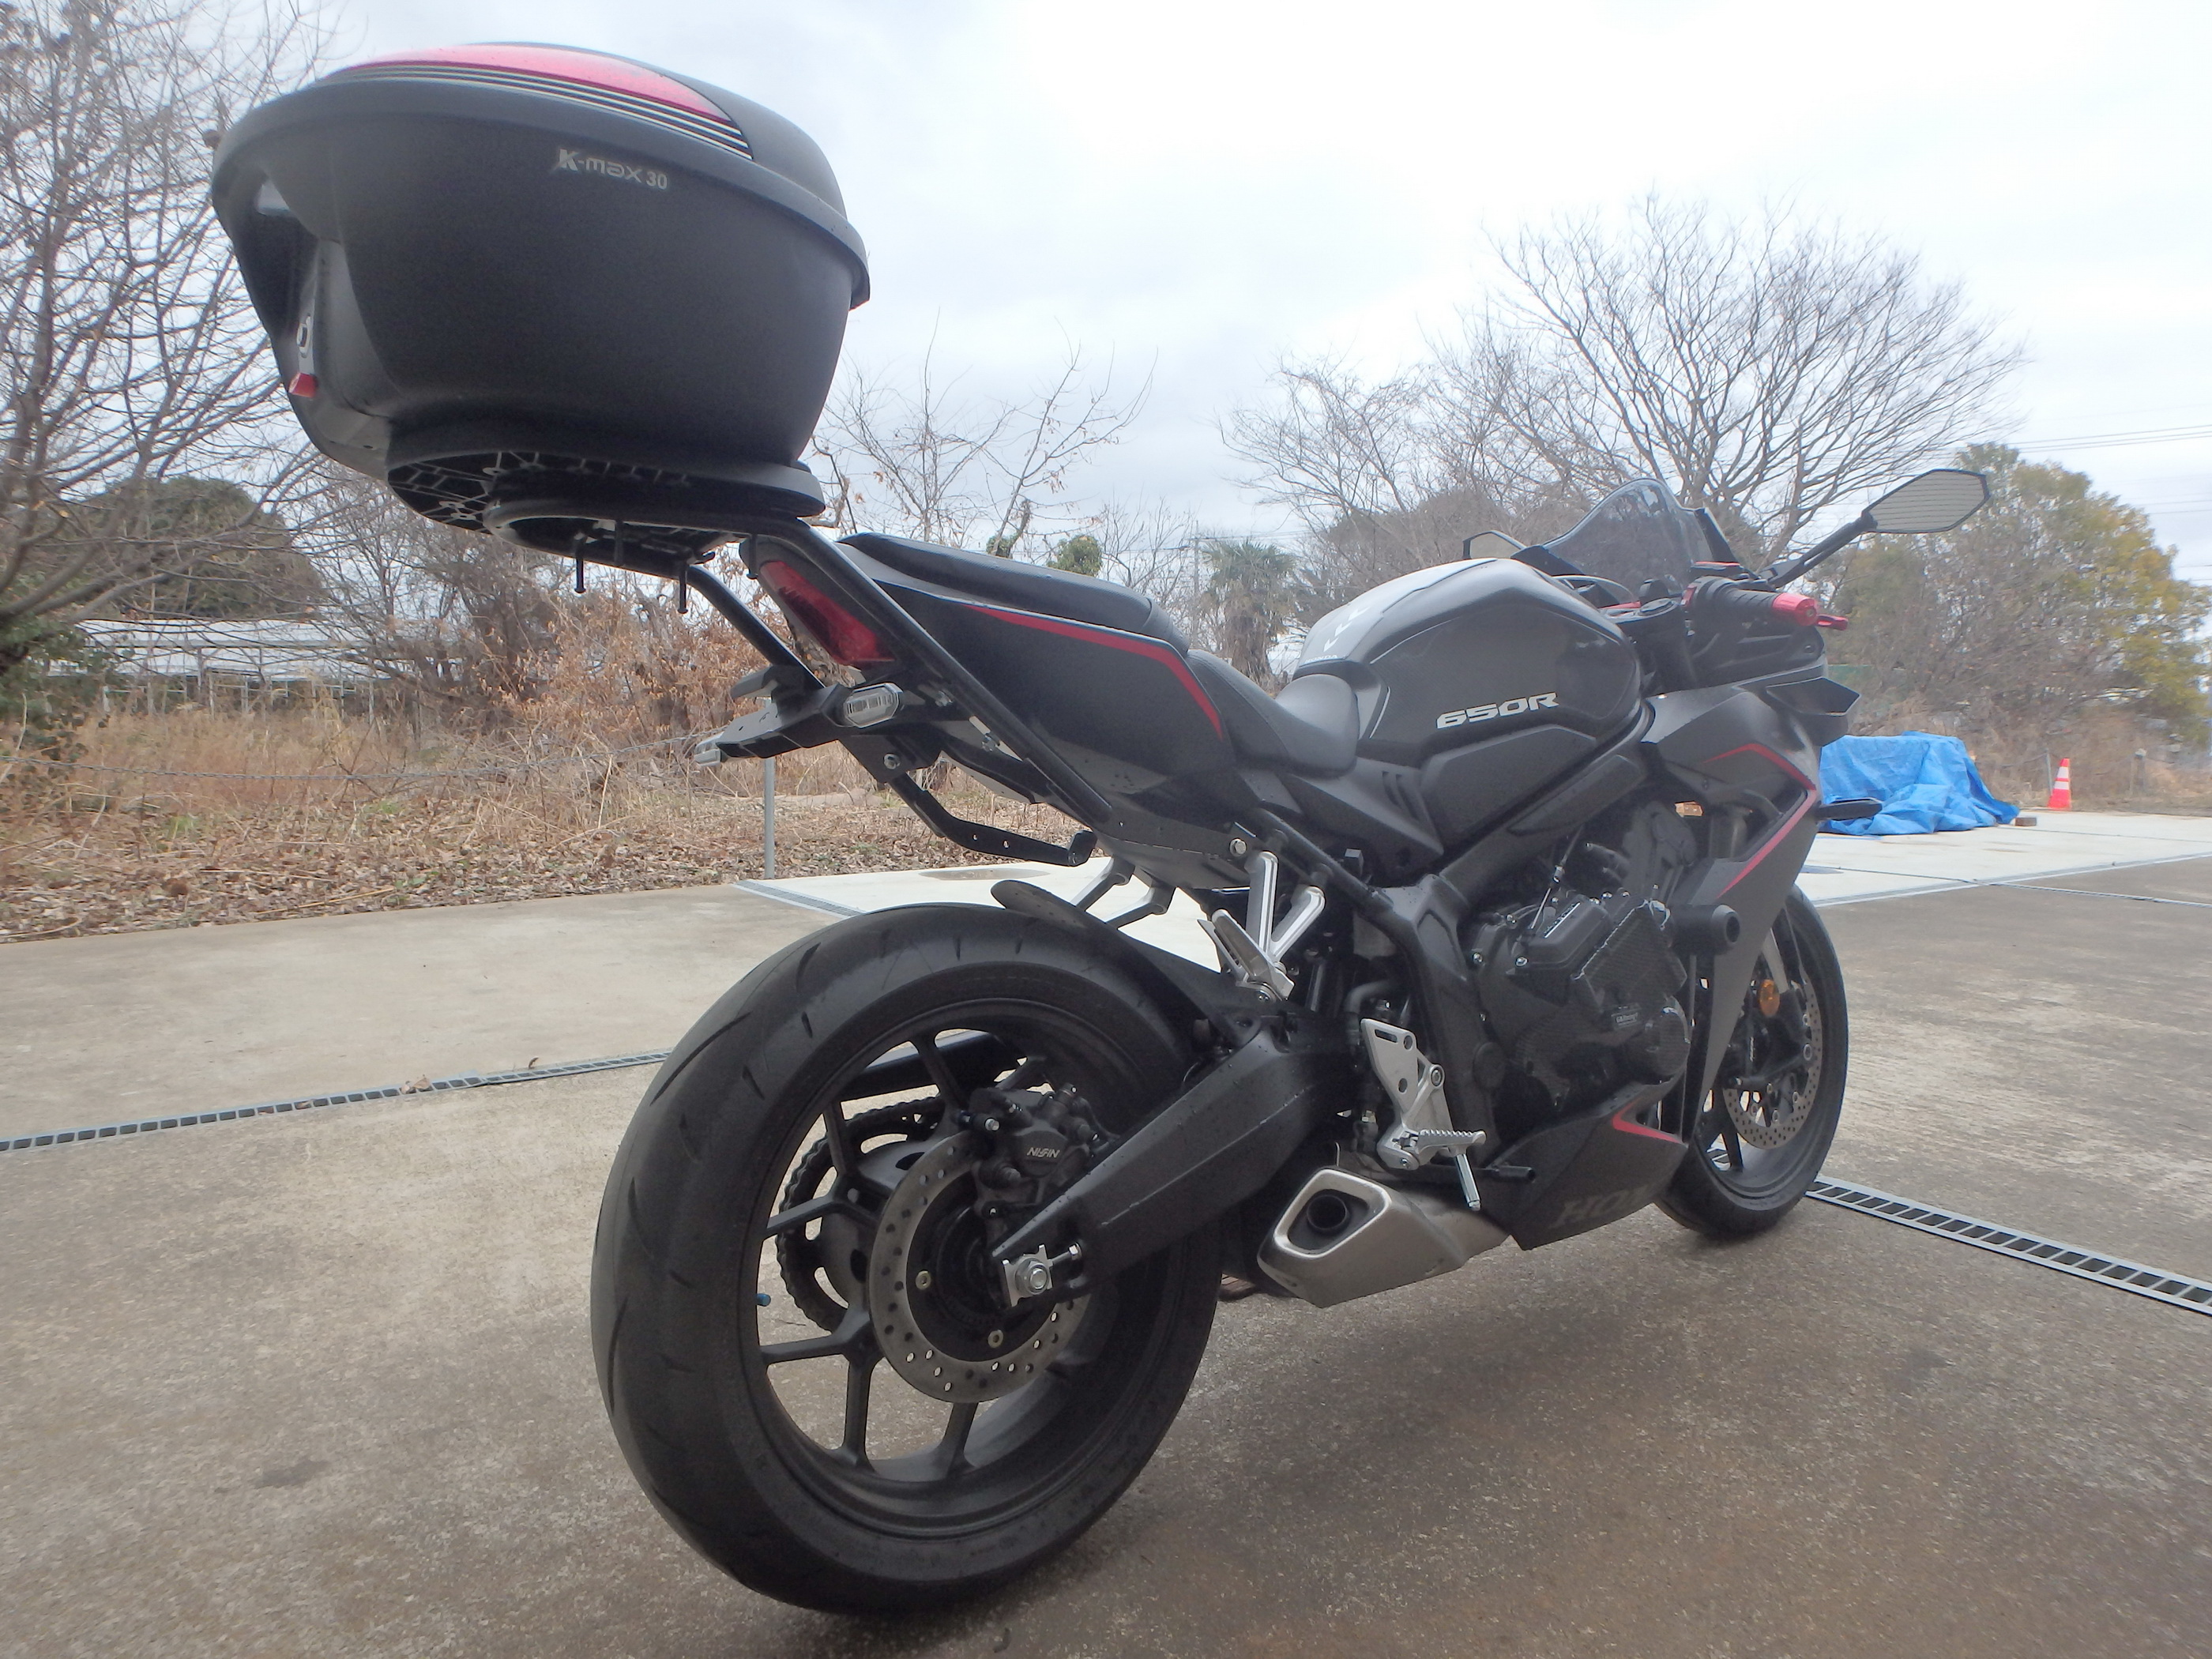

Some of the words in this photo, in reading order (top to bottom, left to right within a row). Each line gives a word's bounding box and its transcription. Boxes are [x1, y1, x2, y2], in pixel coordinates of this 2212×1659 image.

[559, 149, 644, 183] K-max
[646, 171, 668, 190] 30
[1436, 691, 1559, 729] 650R
